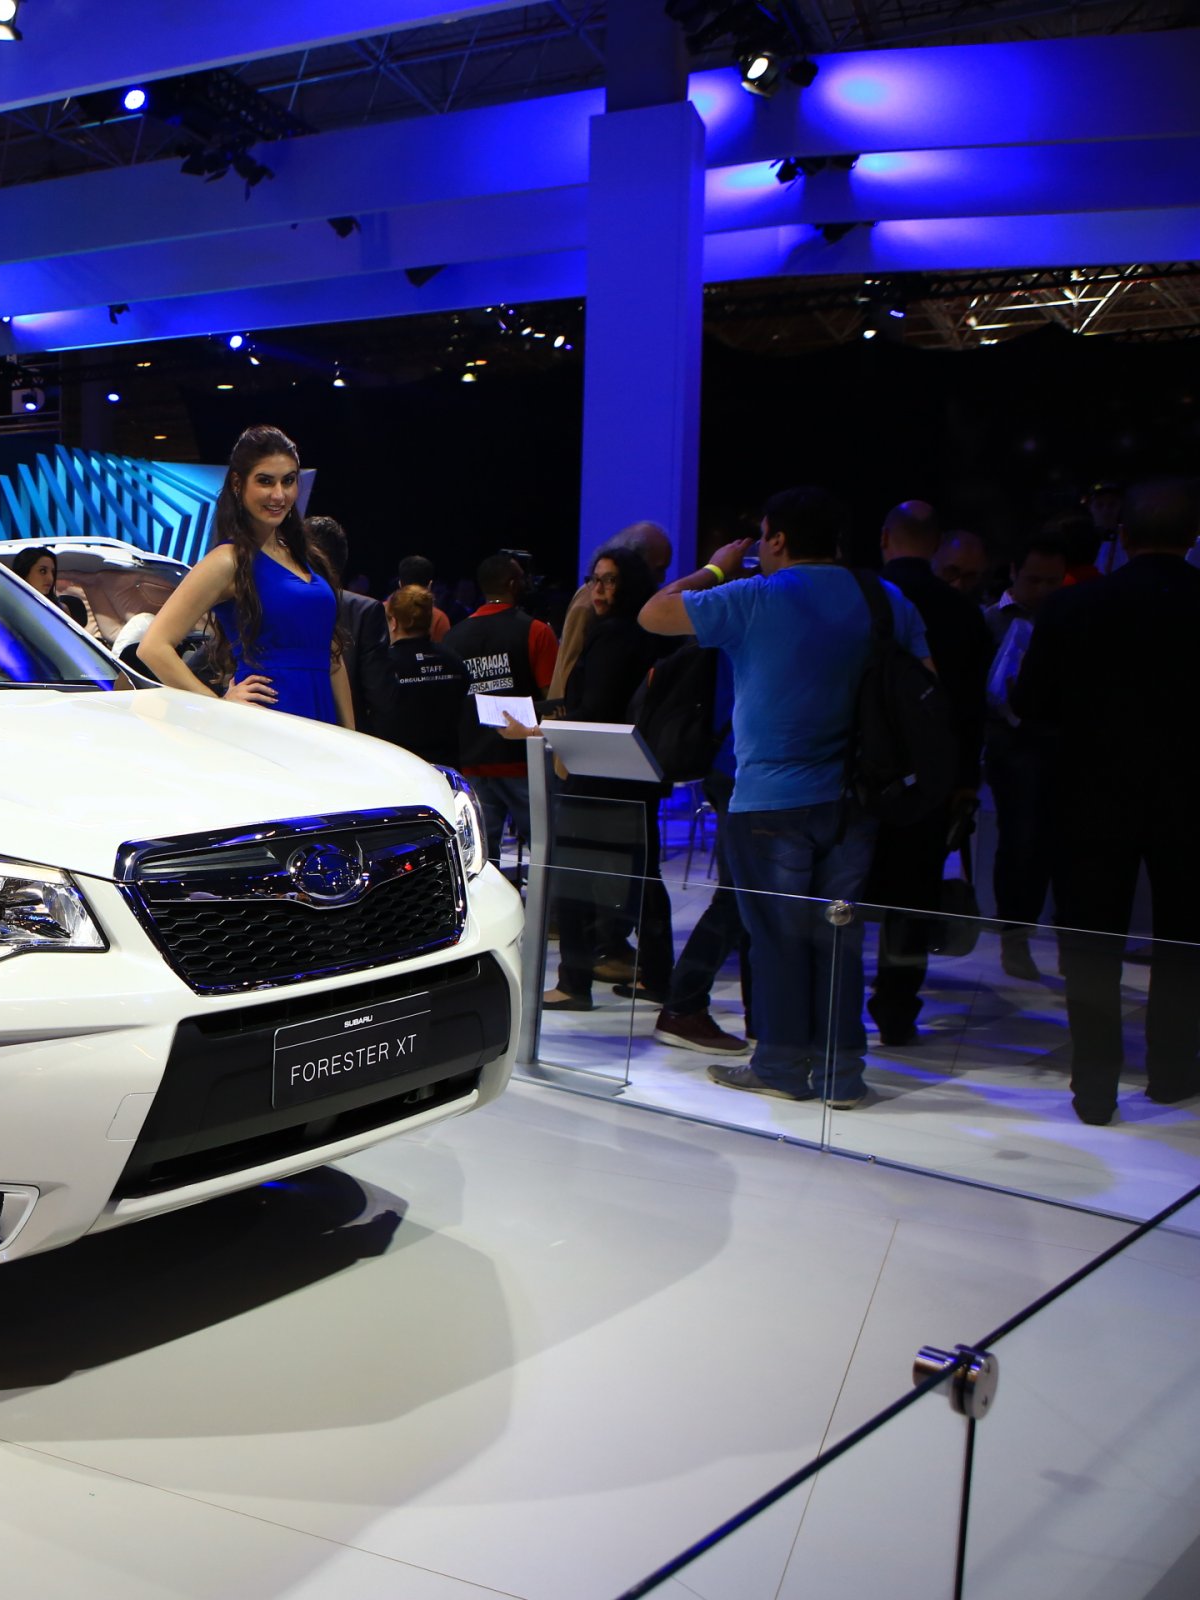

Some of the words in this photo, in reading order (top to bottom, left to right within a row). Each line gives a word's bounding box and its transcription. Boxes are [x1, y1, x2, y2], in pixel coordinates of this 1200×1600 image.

[420, 665, 443, 674] STAFF
[473, 666, 511, 679] EVISION
[493, 678, 513, 689] PRESS
[344, 1014, 373, 1028] SUBARU
[290, 1042, 389, 1086] FORESTER
[396, 1034, 417, 1057] XT
